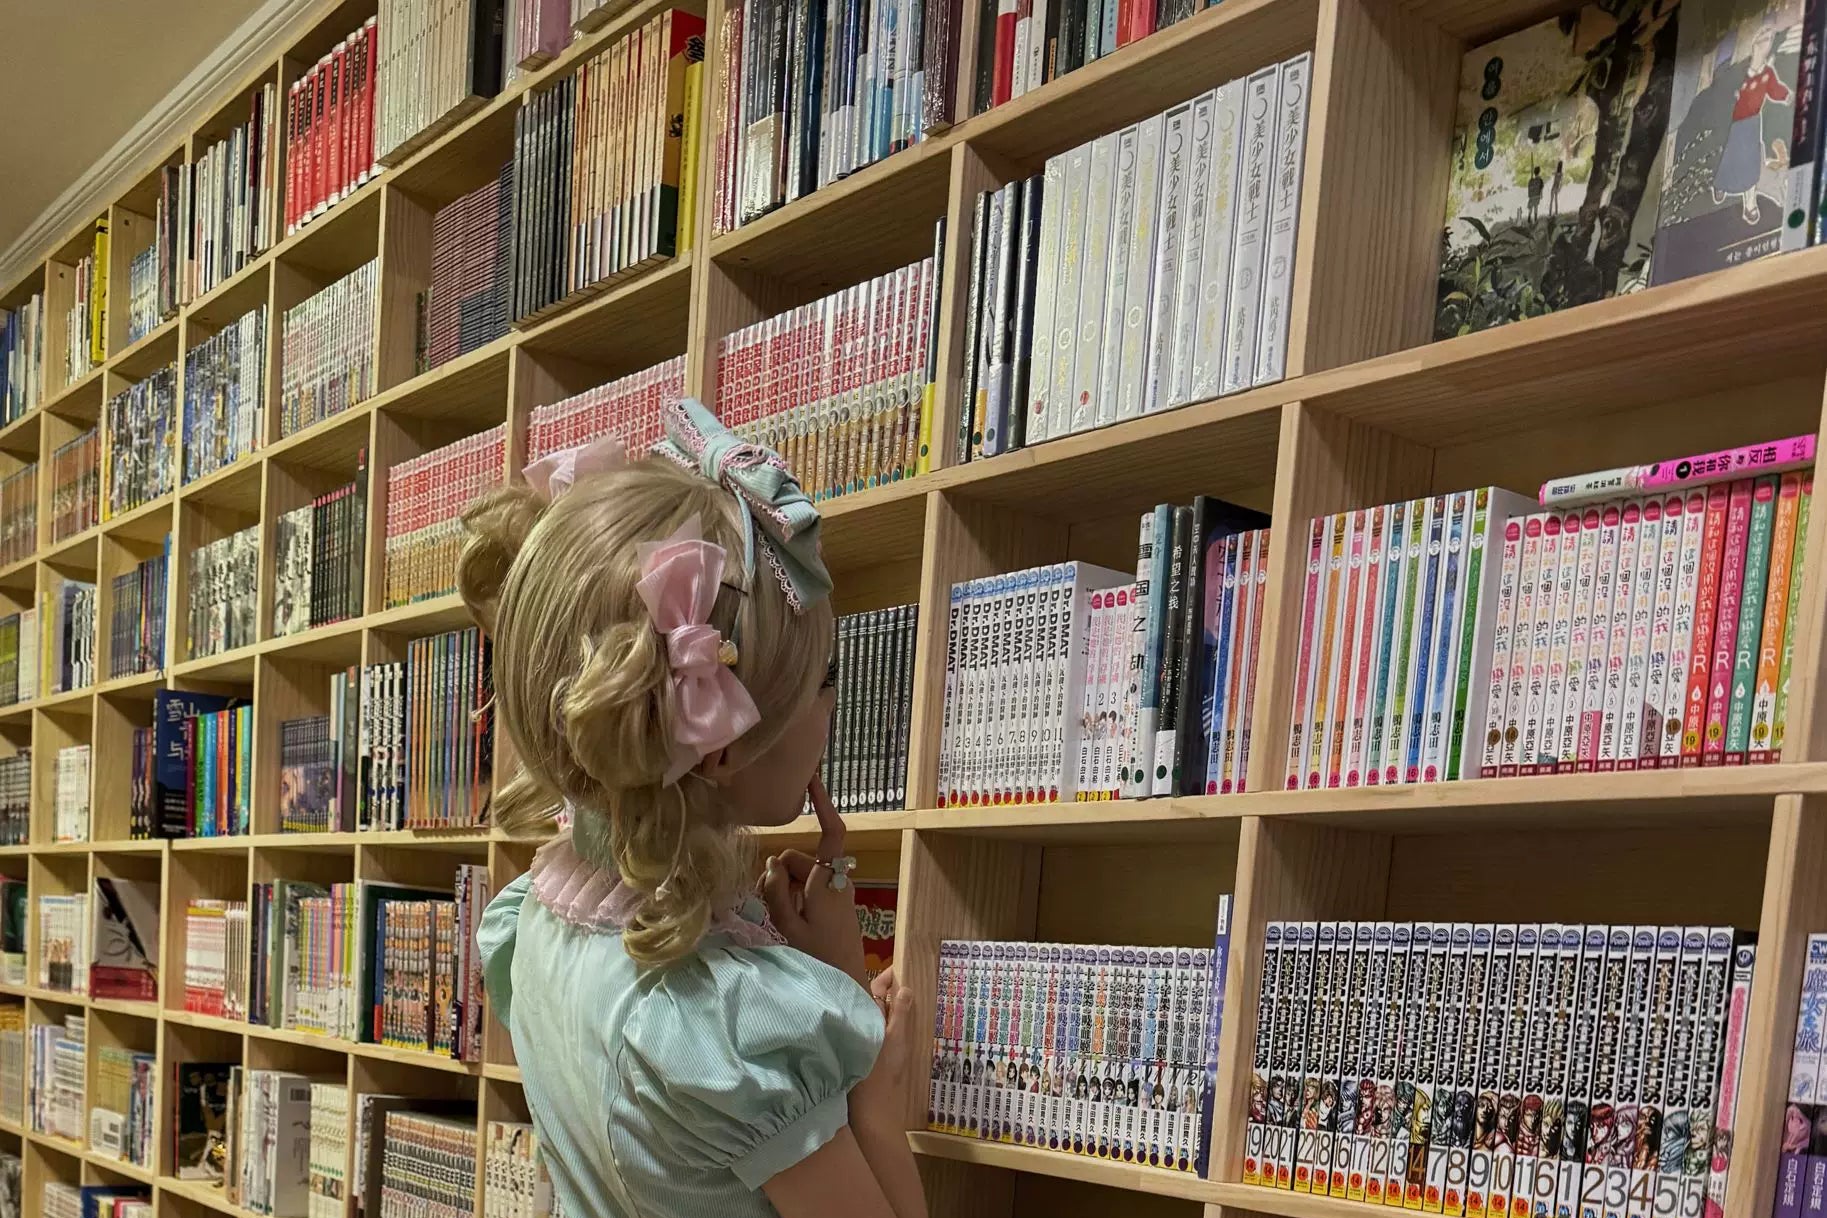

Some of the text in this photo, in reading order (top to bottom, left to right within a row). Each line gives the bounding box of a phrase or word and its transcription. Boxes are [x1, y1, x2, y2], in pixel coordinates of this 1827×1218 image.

[1693, 655, 1706, 674] R
[1715, 651, 1730, 671] R
[1737, 651, 1750, 670] R
[1762, 648, 1775, 667] R
[1099, 693, 1104, 705] 2
[1110, 692, 1117, 704] 3
[955, 736, 961, 748] 2
[965, 737, 970, 748] 3
[975, 735, 981, 747] 4
[986, 734, 992, 746] 5
[998, 733, 1003, 745] 6
[1009, 731, 1015, 743] 7
[1020, 730, 1026, 743] 8
[1031, 730, 1037, 742] 9
[1247, 1126, 1261, 1157] 19
[1264, 1128, 1280, 1160] 20
[1280, 1129, 1295, 1161] 21
[1297, 1130, 1315, 1163] 22
[1315, 1133, 1331, 1165] 18
[1334, 1135, 1350, 1168] 16
[1352, 1138, 1368, 1171] 17
[1370, 1139, 1387, 1173] 12
[1390, 1141, 1406, 1176] 13
[1409, 1149, 1425, 1179] 14
[1429, 1149, 1447, 1182] 7
[1449, 1150, 1465, 1184] 8
[1470, 1153, 1489, 1188] 9
[1494, 1155, 1512, 1191] 10
[1517, 1158, 1534, 1194] 11
[1535, 1161, 1555, 1197] 6
[1561, 1164, 1573, 1201] 1
[1582, 1166, 1605, 1204] 2
[1605, 1170, 1627, 1208] 3
[1629, 1172, 1653, 1211] 4
[1654, 1175, 1678, 1214] 5
[1679, 1177, 1700, 1218] 15
